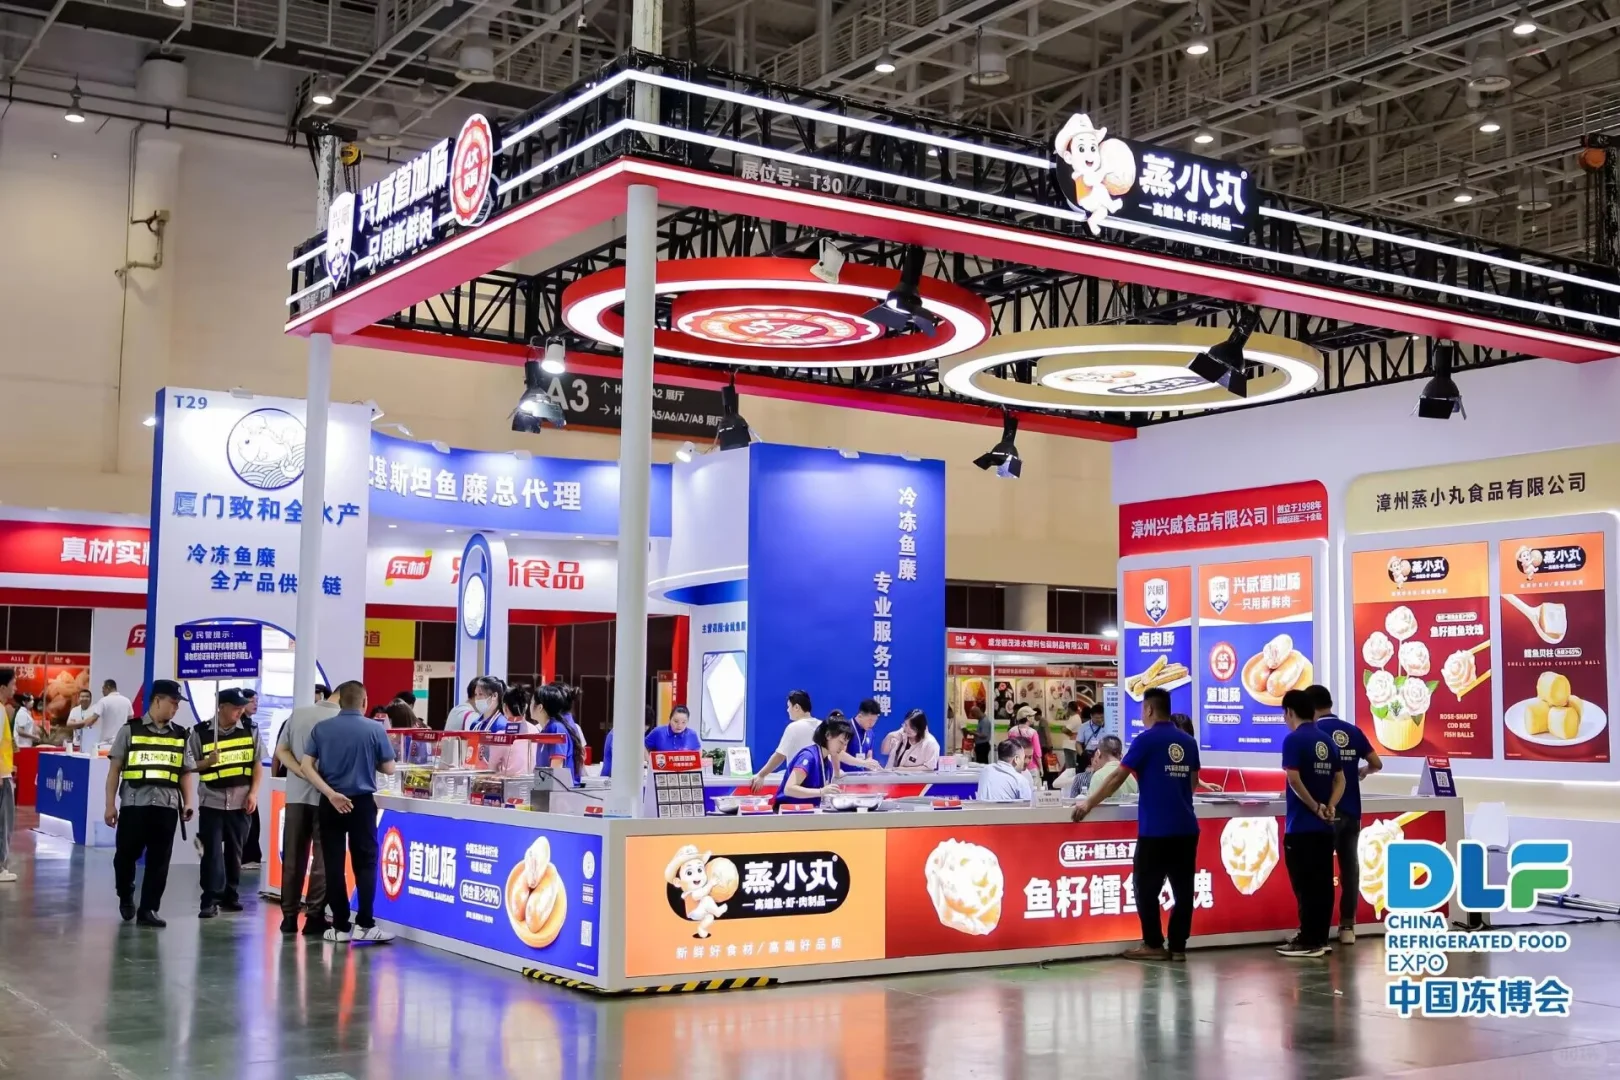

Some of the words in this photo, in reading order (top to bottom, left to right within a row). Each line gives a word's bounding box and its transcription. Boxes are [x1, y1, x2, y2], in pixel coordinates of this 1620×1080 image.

[358, 138, 449, 232] 兴威道地肠
[1139, 154, 1246, 214] 蒸小丸
[174, 395, 208, 410] T29
[547, 376, 590, 412] A3
[665, 389, 685, 402] 展厅
[1376, 472, 1586, 513] 漳州蒸小丸食品有限公司
[898, 486, 918, 581] 冷冻鱼糜
[1131, 507, 1268, 539] 漳州兴威食品有限公司
[187, 544, 276, 568] 冷冻鱼糜
[390, 560, 427, 577] 乐林
[1543, 548, 1581, 564] 蒸小丸
[210, 571, 342, 596] 全产品供链
[1233, 572, 1301, 595] 兴威道地肠
[1242, 595, 1291, 610] 只用新鲜肉
[873, 571, 893, 717] 专业服务品牌
[1099, 643, 1112, 652] T41
[1139, 631, 1175, 647] 卤肉肠
[1207, 687, 1240, 703] 道地肠
[409, 841, 456, 889] 道地肠
[742, 859, 838, 894] 蒸小丸
[1023, 869, 1214, 919] 鱼籽鳕瑰
